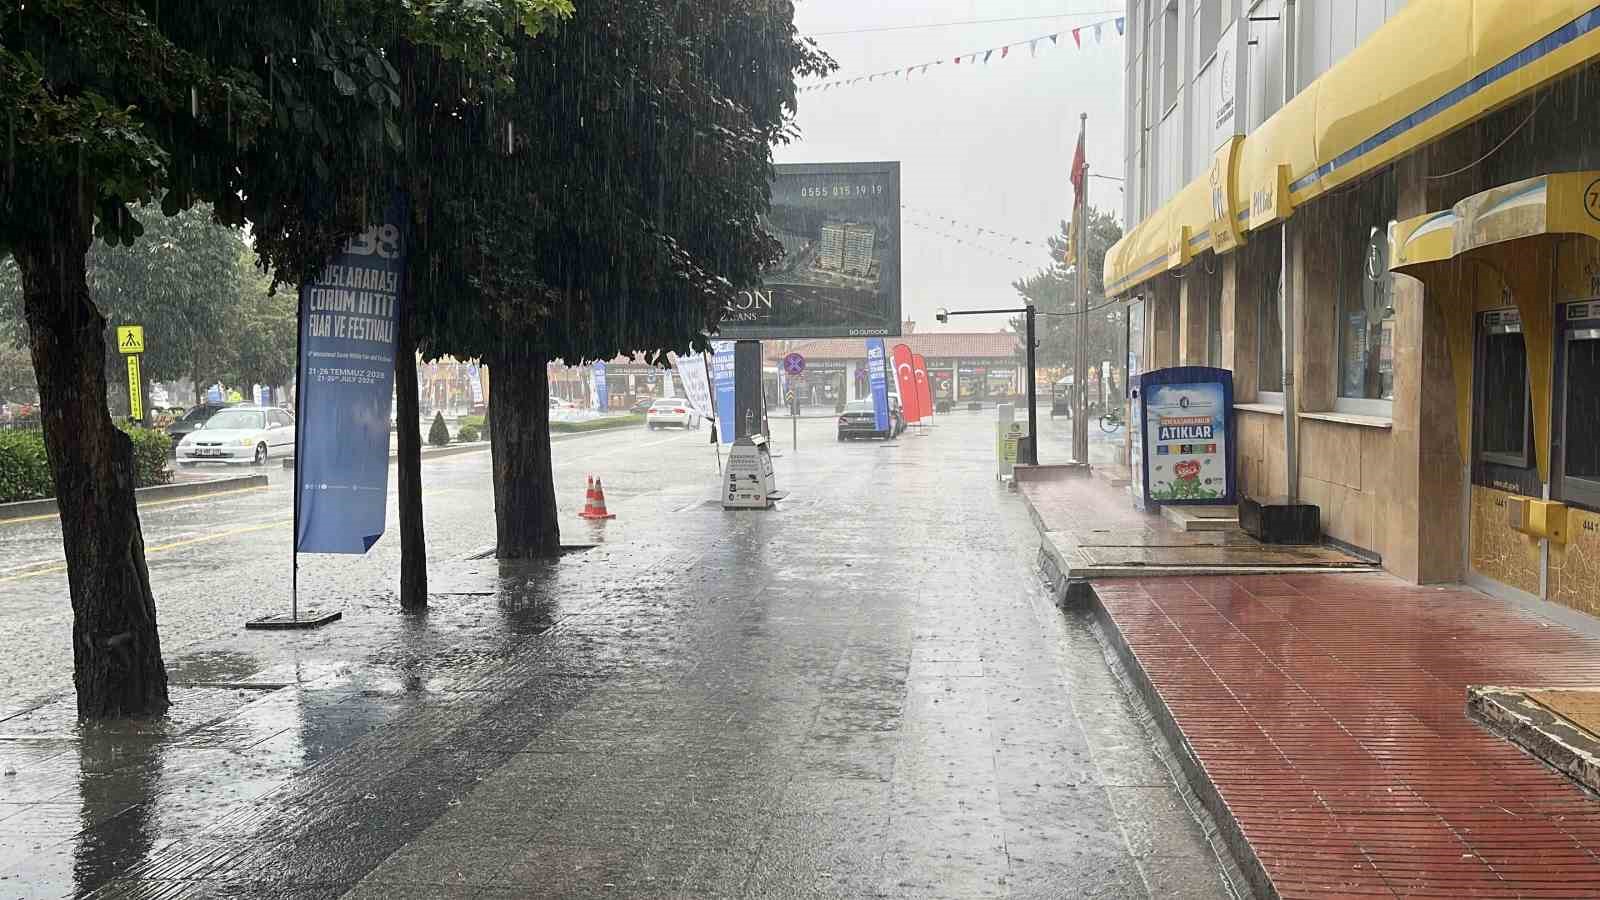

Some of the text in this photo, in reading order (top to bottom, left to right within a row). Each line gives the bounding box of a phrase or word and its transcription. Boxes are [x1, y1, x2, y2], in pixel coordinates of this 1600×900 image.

[308, 314, 332, 337] FUAR
[334, 315, 347, 339] VE
[331, 368, 366, 377] TEMMUZ
[1161, 426, 1211, 439] ATIKLAR
